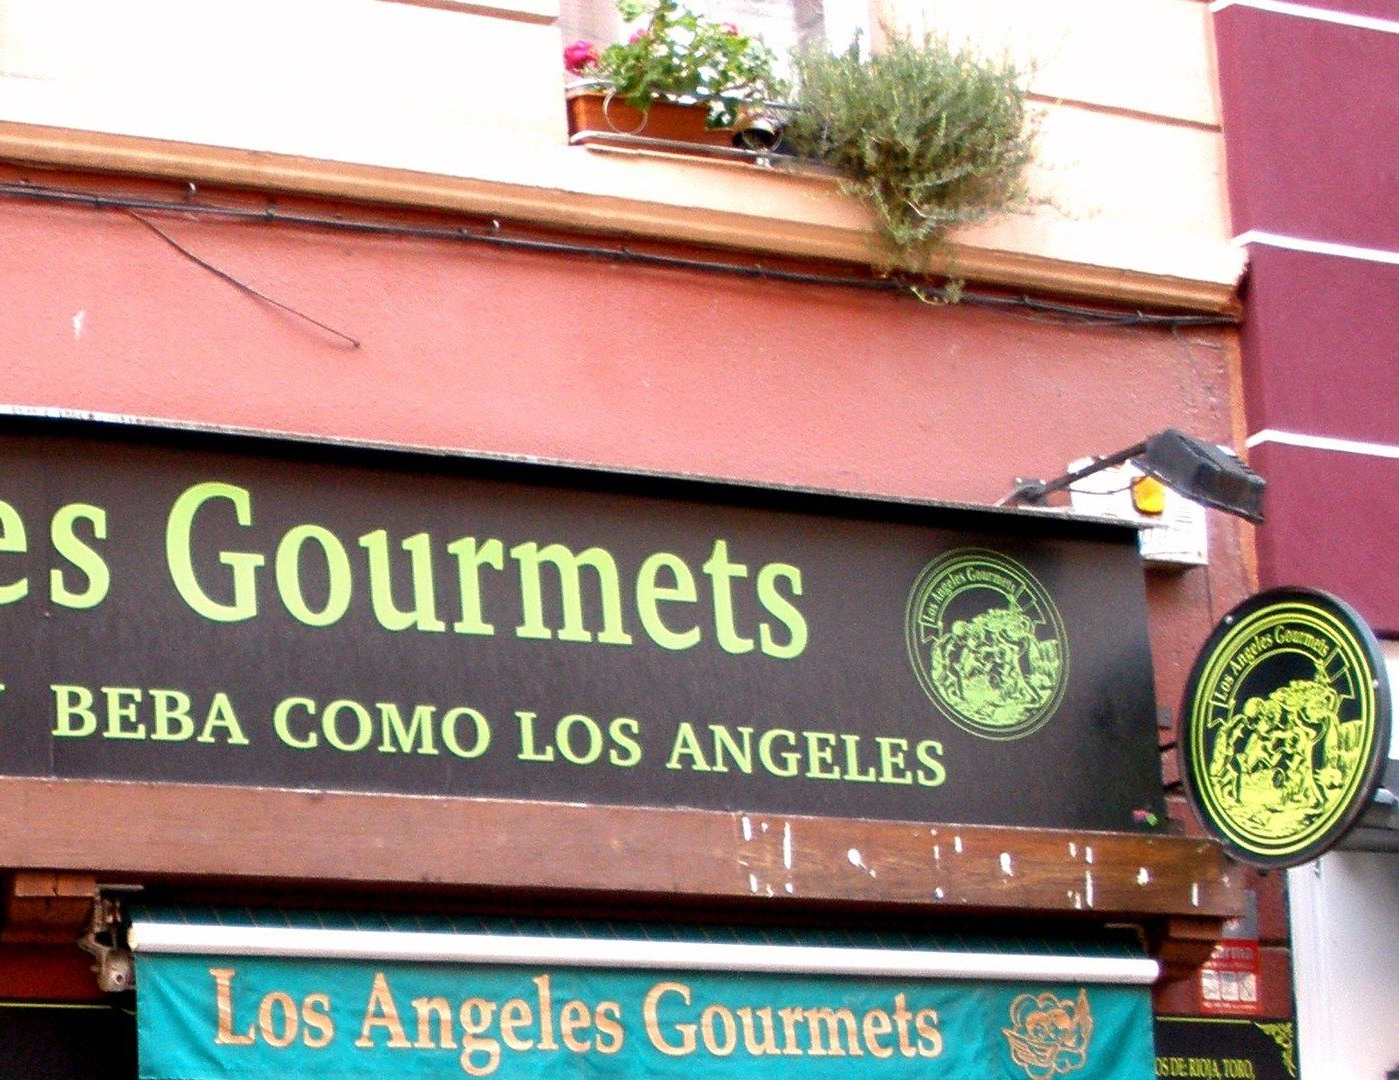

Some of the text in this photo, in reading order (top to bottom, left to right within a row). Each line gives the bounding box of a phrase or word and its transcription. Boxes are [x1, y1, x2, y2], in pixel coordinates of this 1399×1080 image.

[165, 481, 809, 660] Gourmets
[1214, 625, 1330, 708] Los Angeles Gourmets
[51, 684, 248, 745] BEBA
[273, 696, 491, 759] COMO
[516, 711, 642, 767] LOS
[668, 723, 947, 787] ANGELES
[210, 968, 943, 1076] Los Angeles Gourmets
